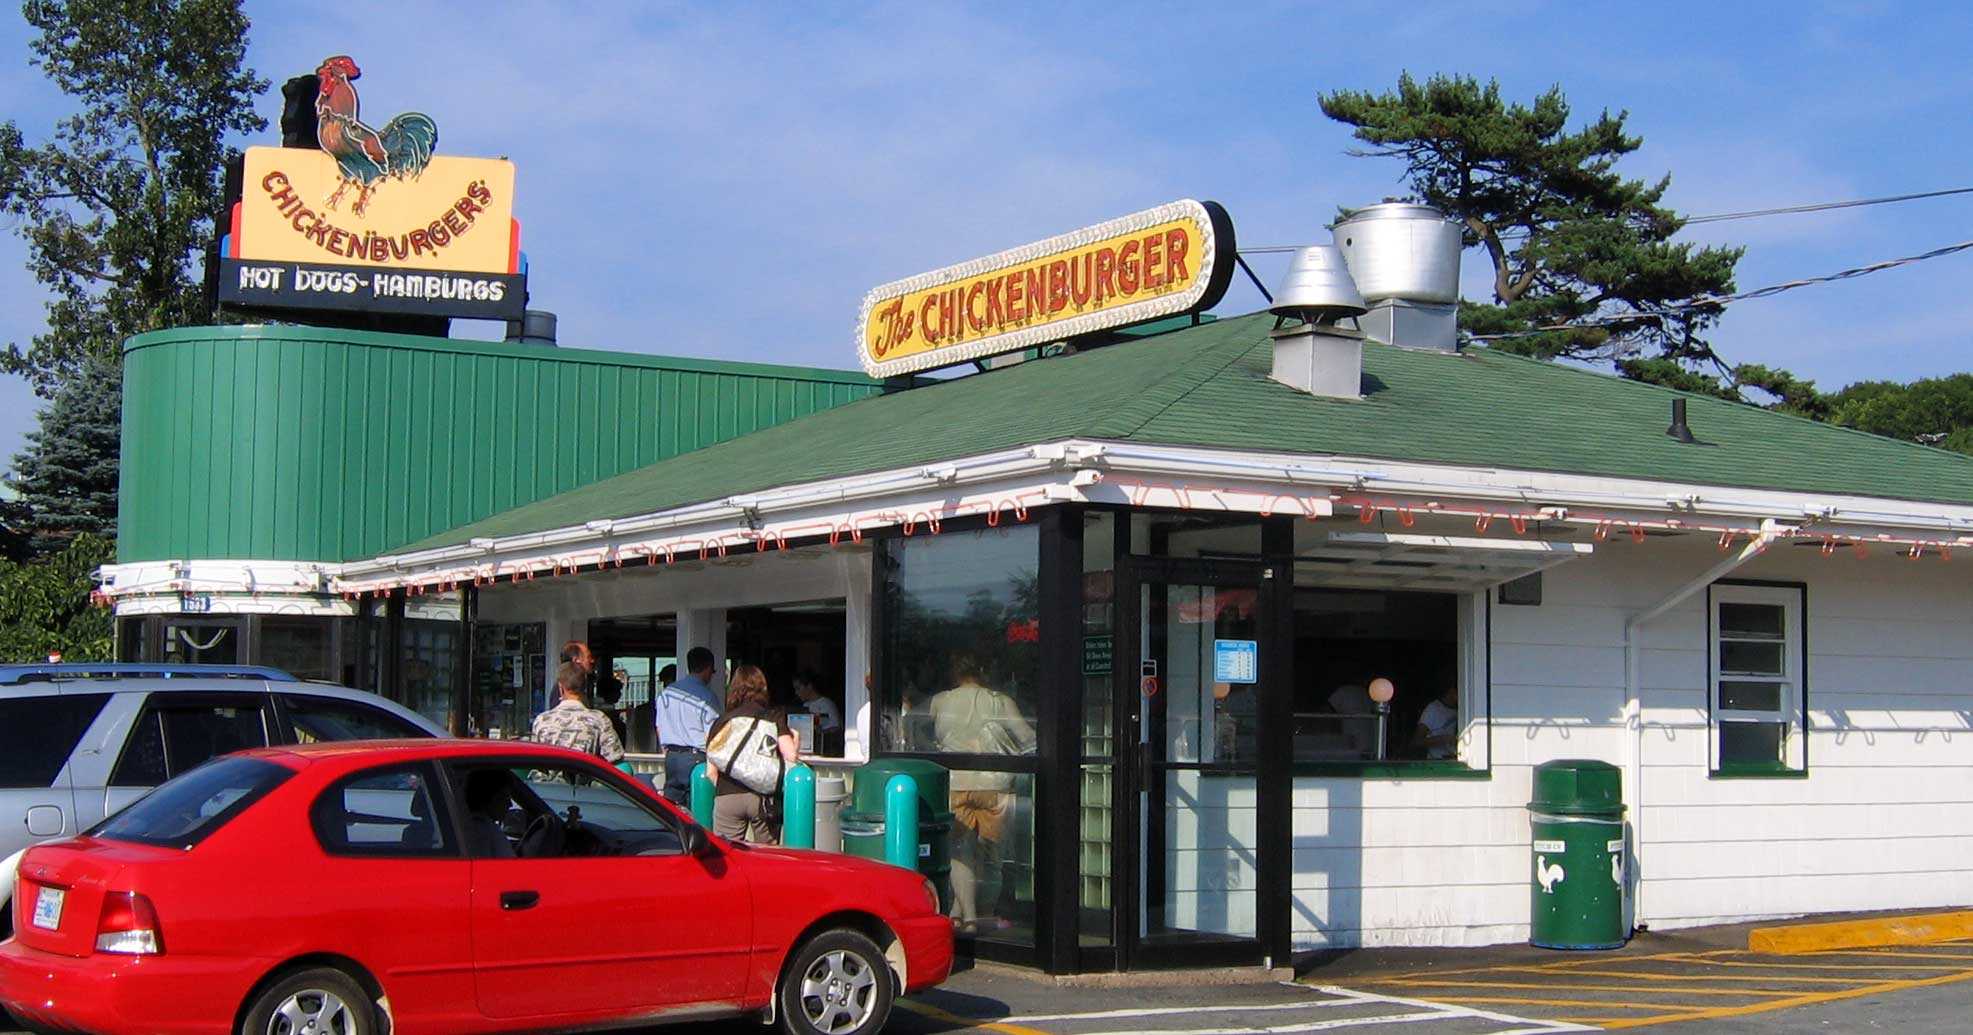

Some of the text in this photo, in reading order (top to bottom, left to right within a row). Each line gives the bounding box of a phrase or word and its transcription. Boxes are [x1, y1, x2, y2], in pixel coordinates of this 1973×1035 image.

[262, 171, 493, 262] CHICKENBURGERS
[239, 266, 285, 290] HOT
[373, 273, 506, 301] HAMBURGS
[875, 227, 1189, 357] The CHICKENBURGER
